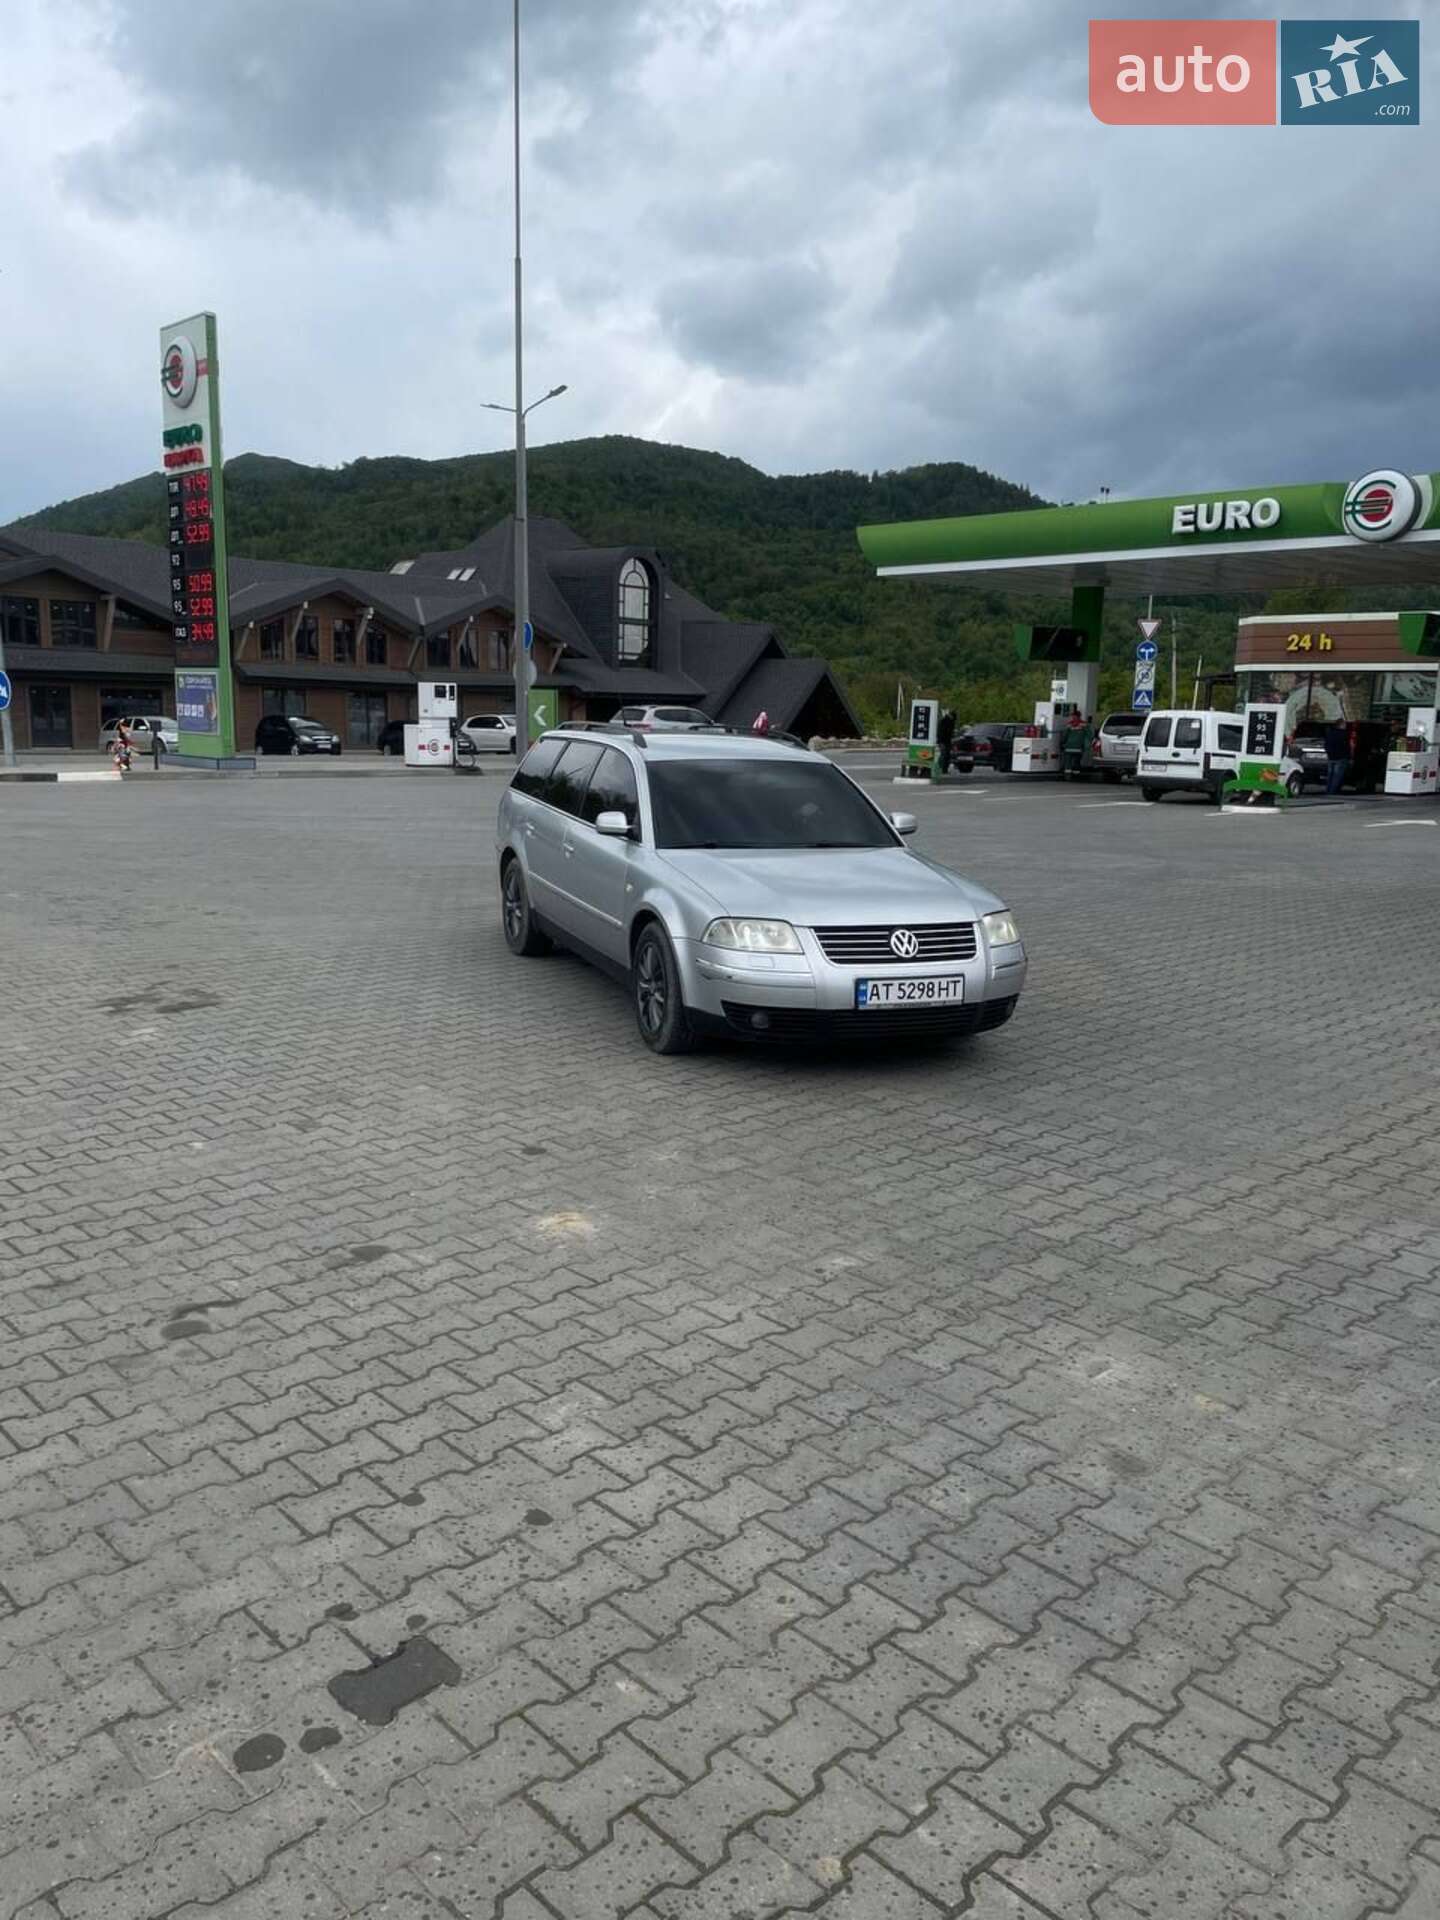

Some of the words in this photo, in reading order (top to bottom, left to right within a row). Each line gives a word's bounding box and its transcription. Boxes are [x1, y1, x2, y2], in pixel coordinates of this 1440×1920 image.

[1172, 498, 1280, 534] EURO
[1286, 634, 1312, 650] 24
[1320, 633, 1331, 650] h
[869, 984, 893, 1000] AT
[897, 982, 935, 999] 5298
[938, 980, 960, 998] HT
